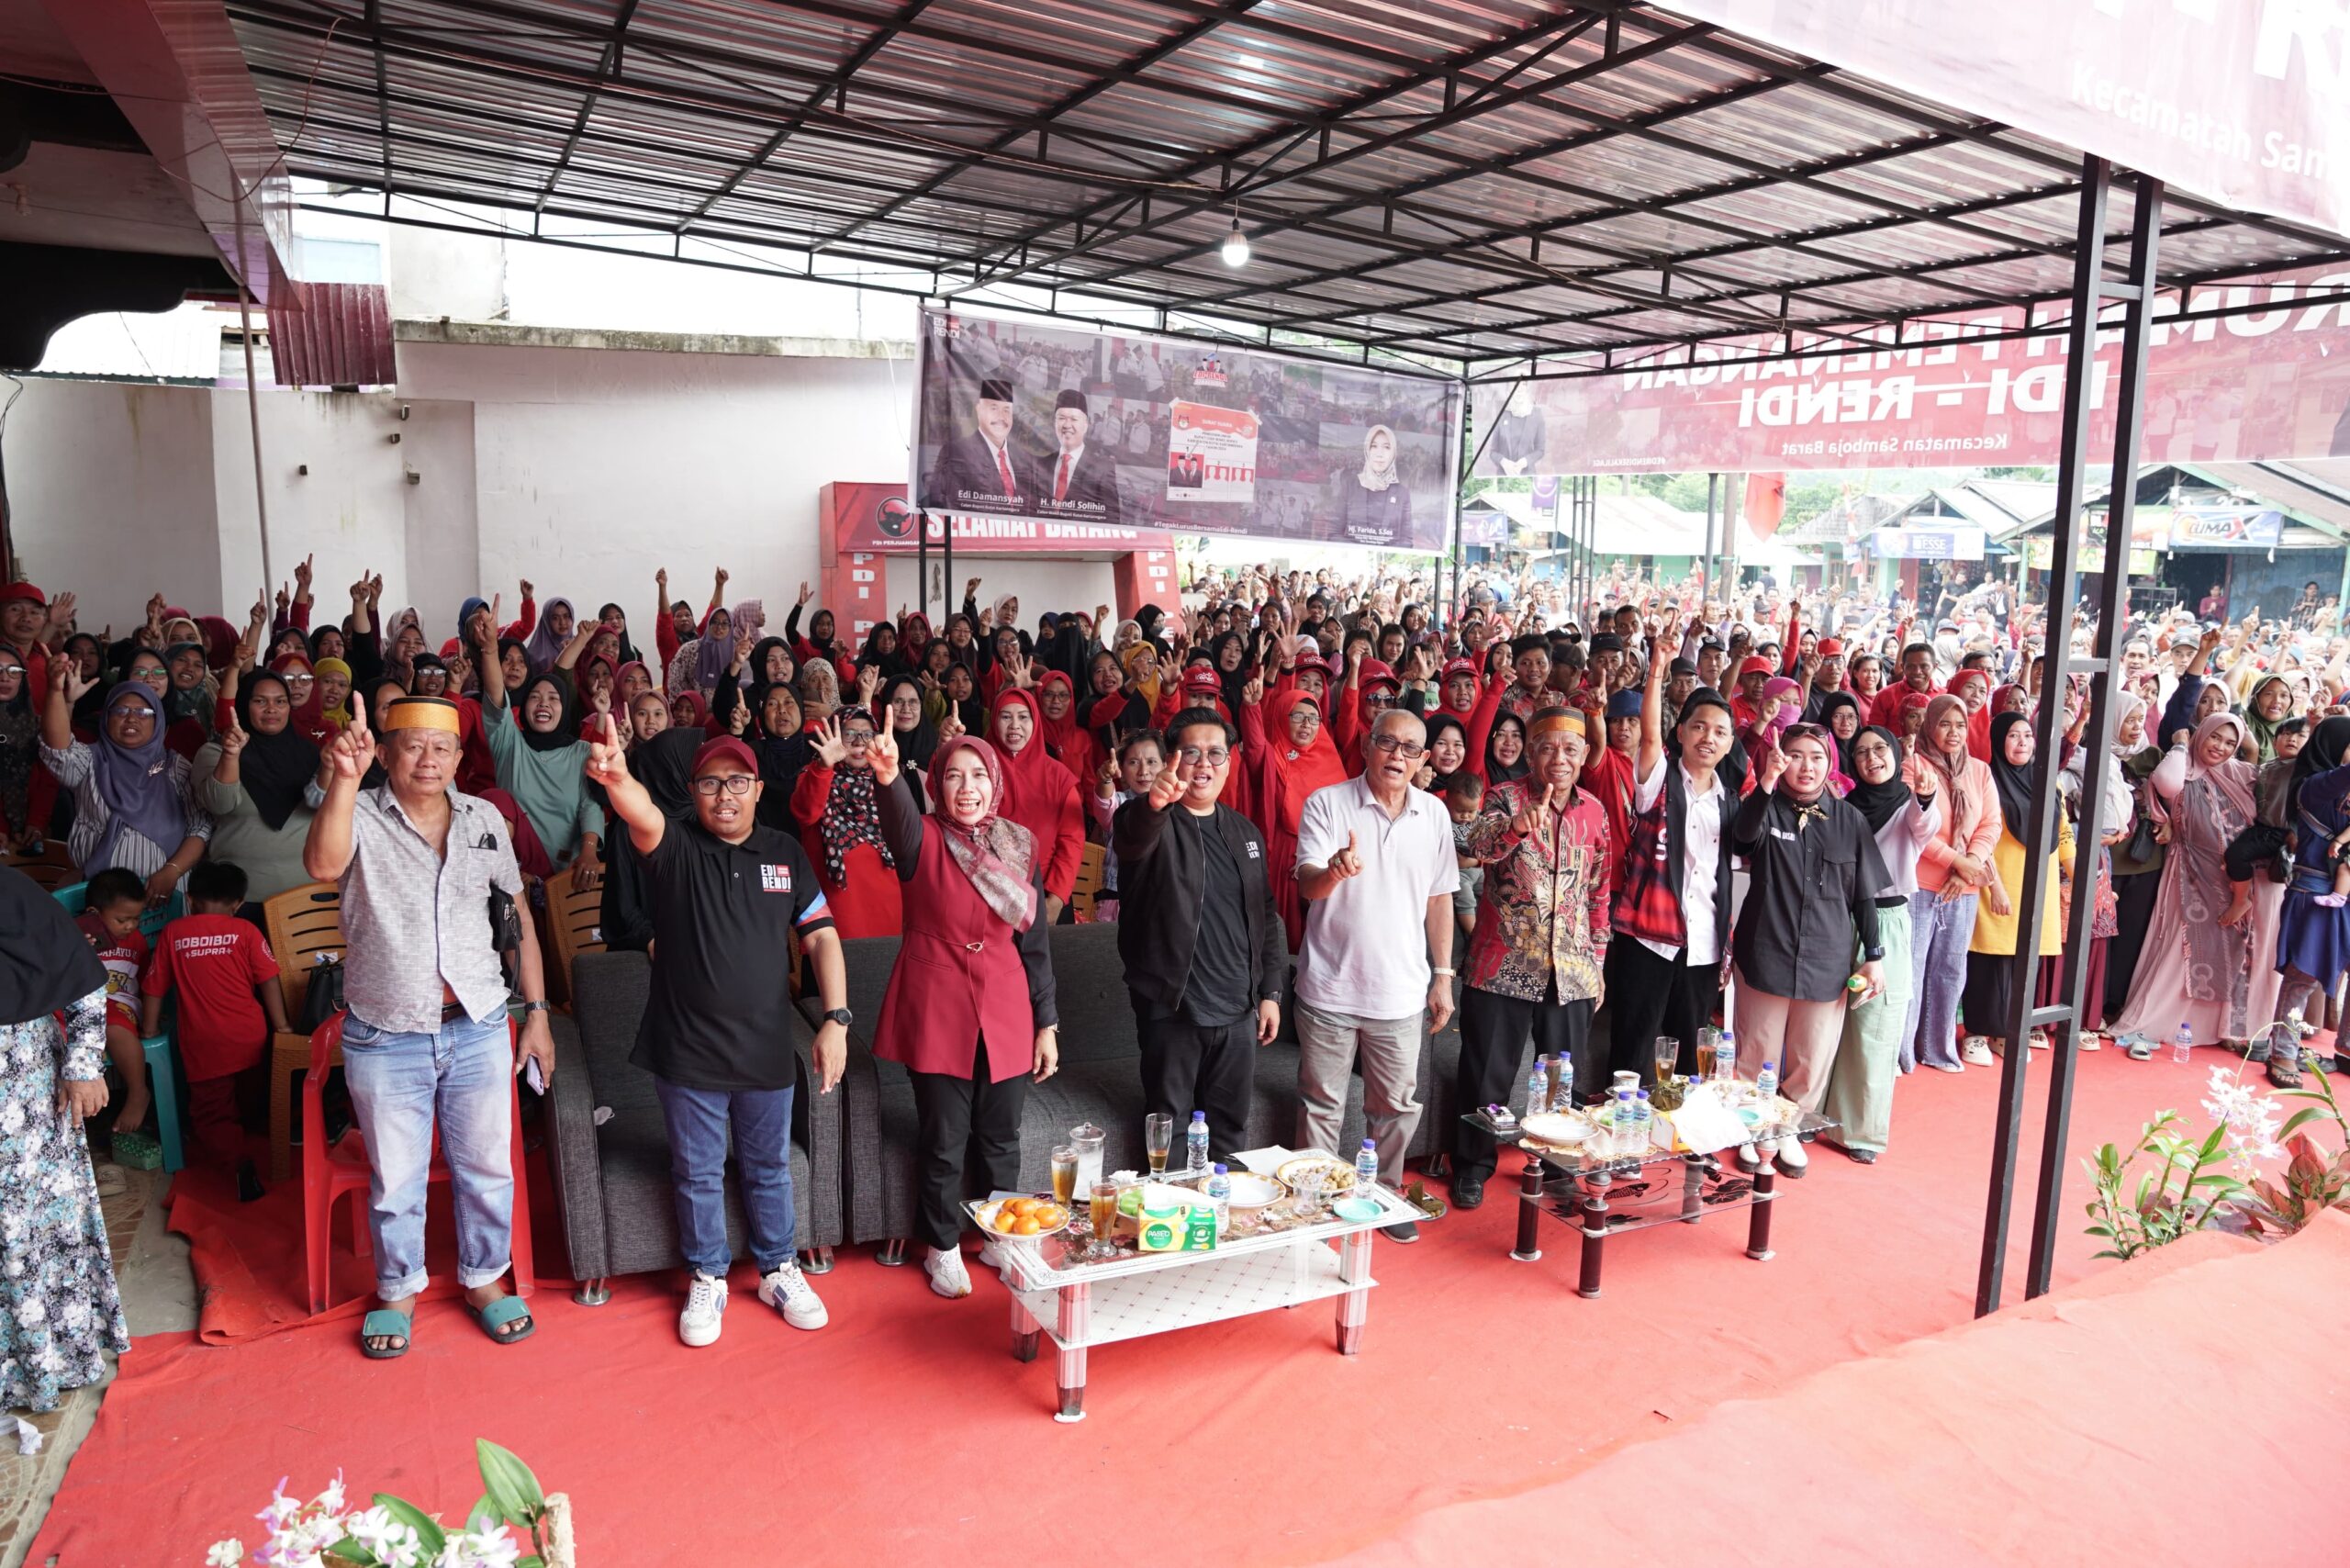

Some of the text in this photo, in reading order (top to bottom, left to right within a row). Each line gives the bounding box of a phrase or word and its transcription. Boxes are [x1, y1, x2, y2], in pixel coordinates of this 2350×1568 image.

[934, 327, 960, 340] RENDI
[958, 489, 1024, 505] Edi Damansyah
[1040, 498, 1106, 511] H. Rendi Solihin
[1922, 538, 1947, 551] ESSE
[853, 553, 875, 599] PDI
[1147, 551, 1169, 593] PDI
[760, 864, 777, 877] EDI
[762, 876, 791, 890] RENDI
[174, 934, 239, 952] BOBOIBOY
[190, 947, 226, 958] SUPRA
